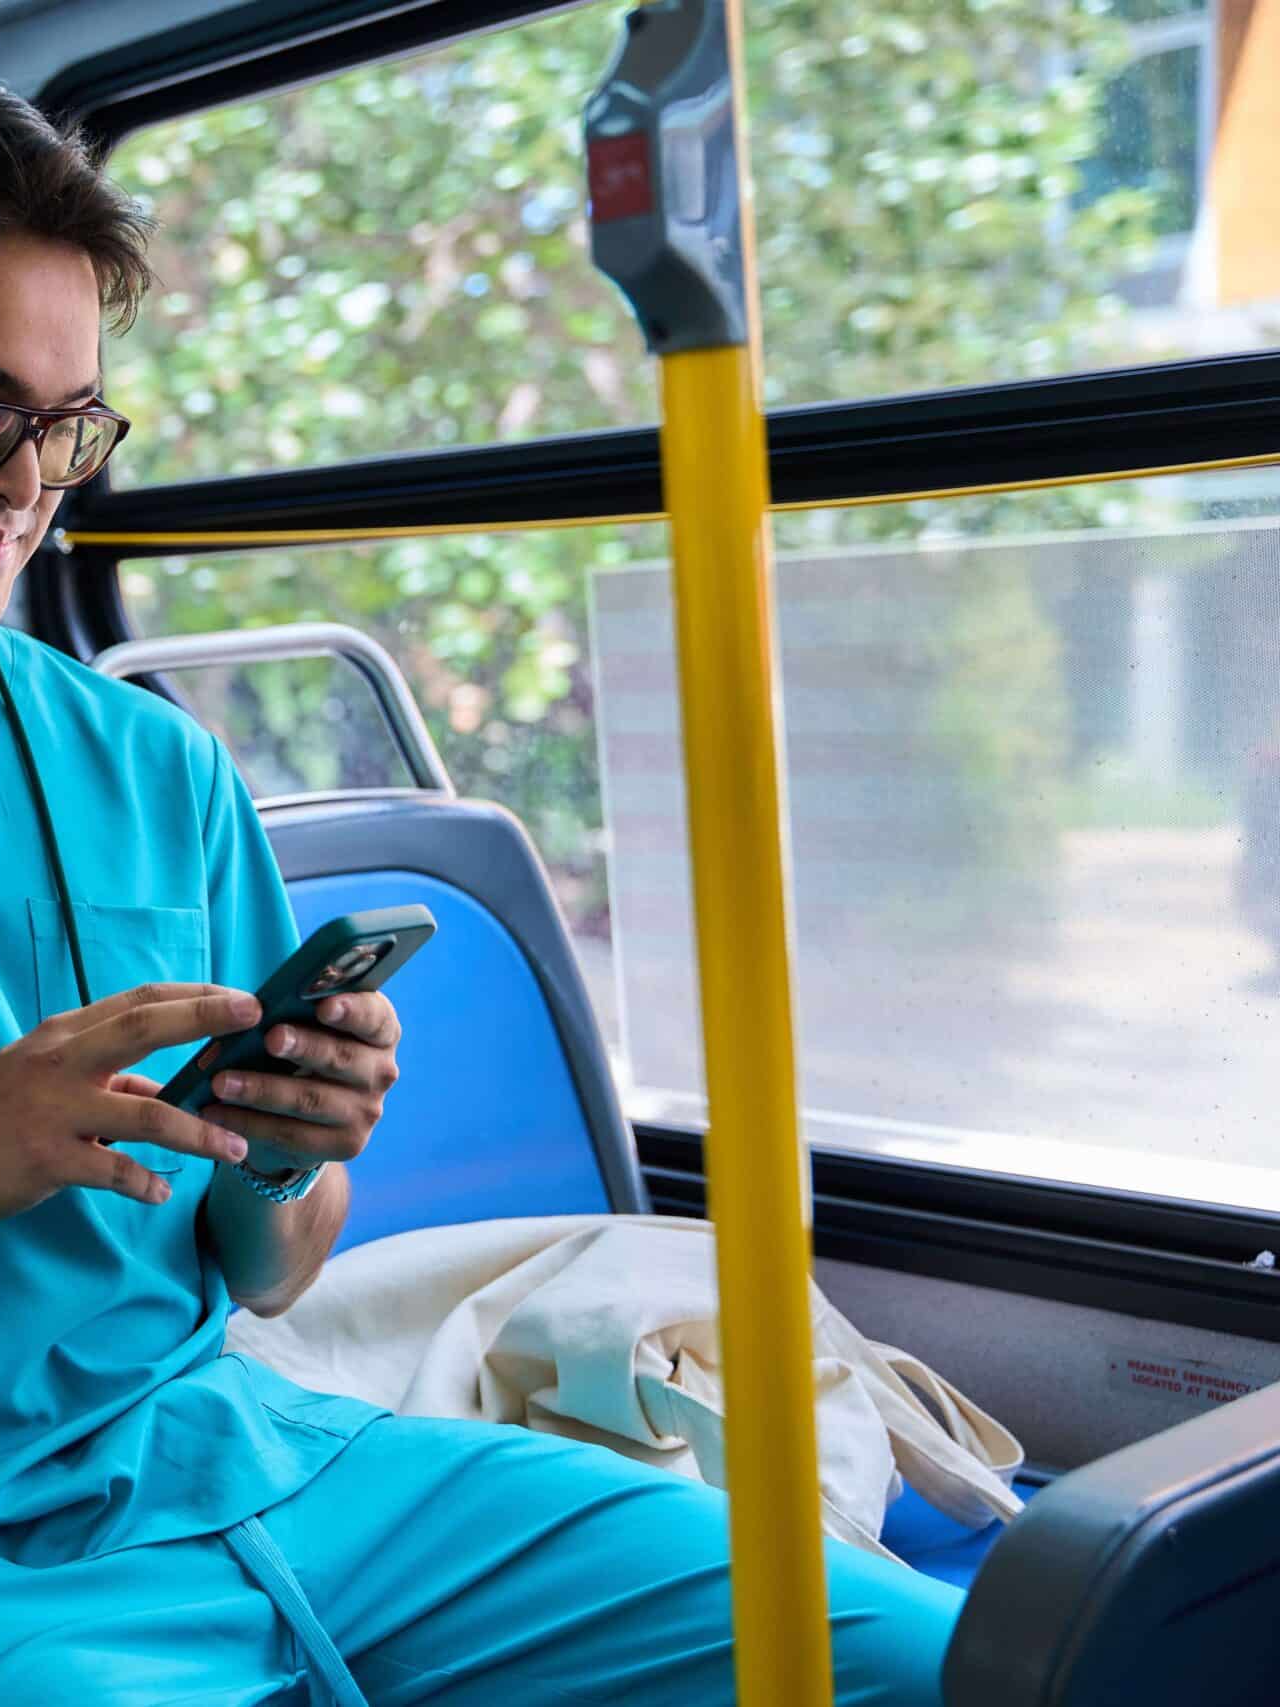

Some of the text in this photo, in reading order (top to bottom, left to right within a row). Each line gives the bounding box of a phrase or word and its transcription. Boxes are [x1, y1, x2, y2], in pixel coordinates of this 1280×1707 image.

[1131, 1373, 1182, 1393] LOCATED
[1186, 1385, 1200, 1397] AT
[1183, 1369, 1250, 1393] EMERGENCY
